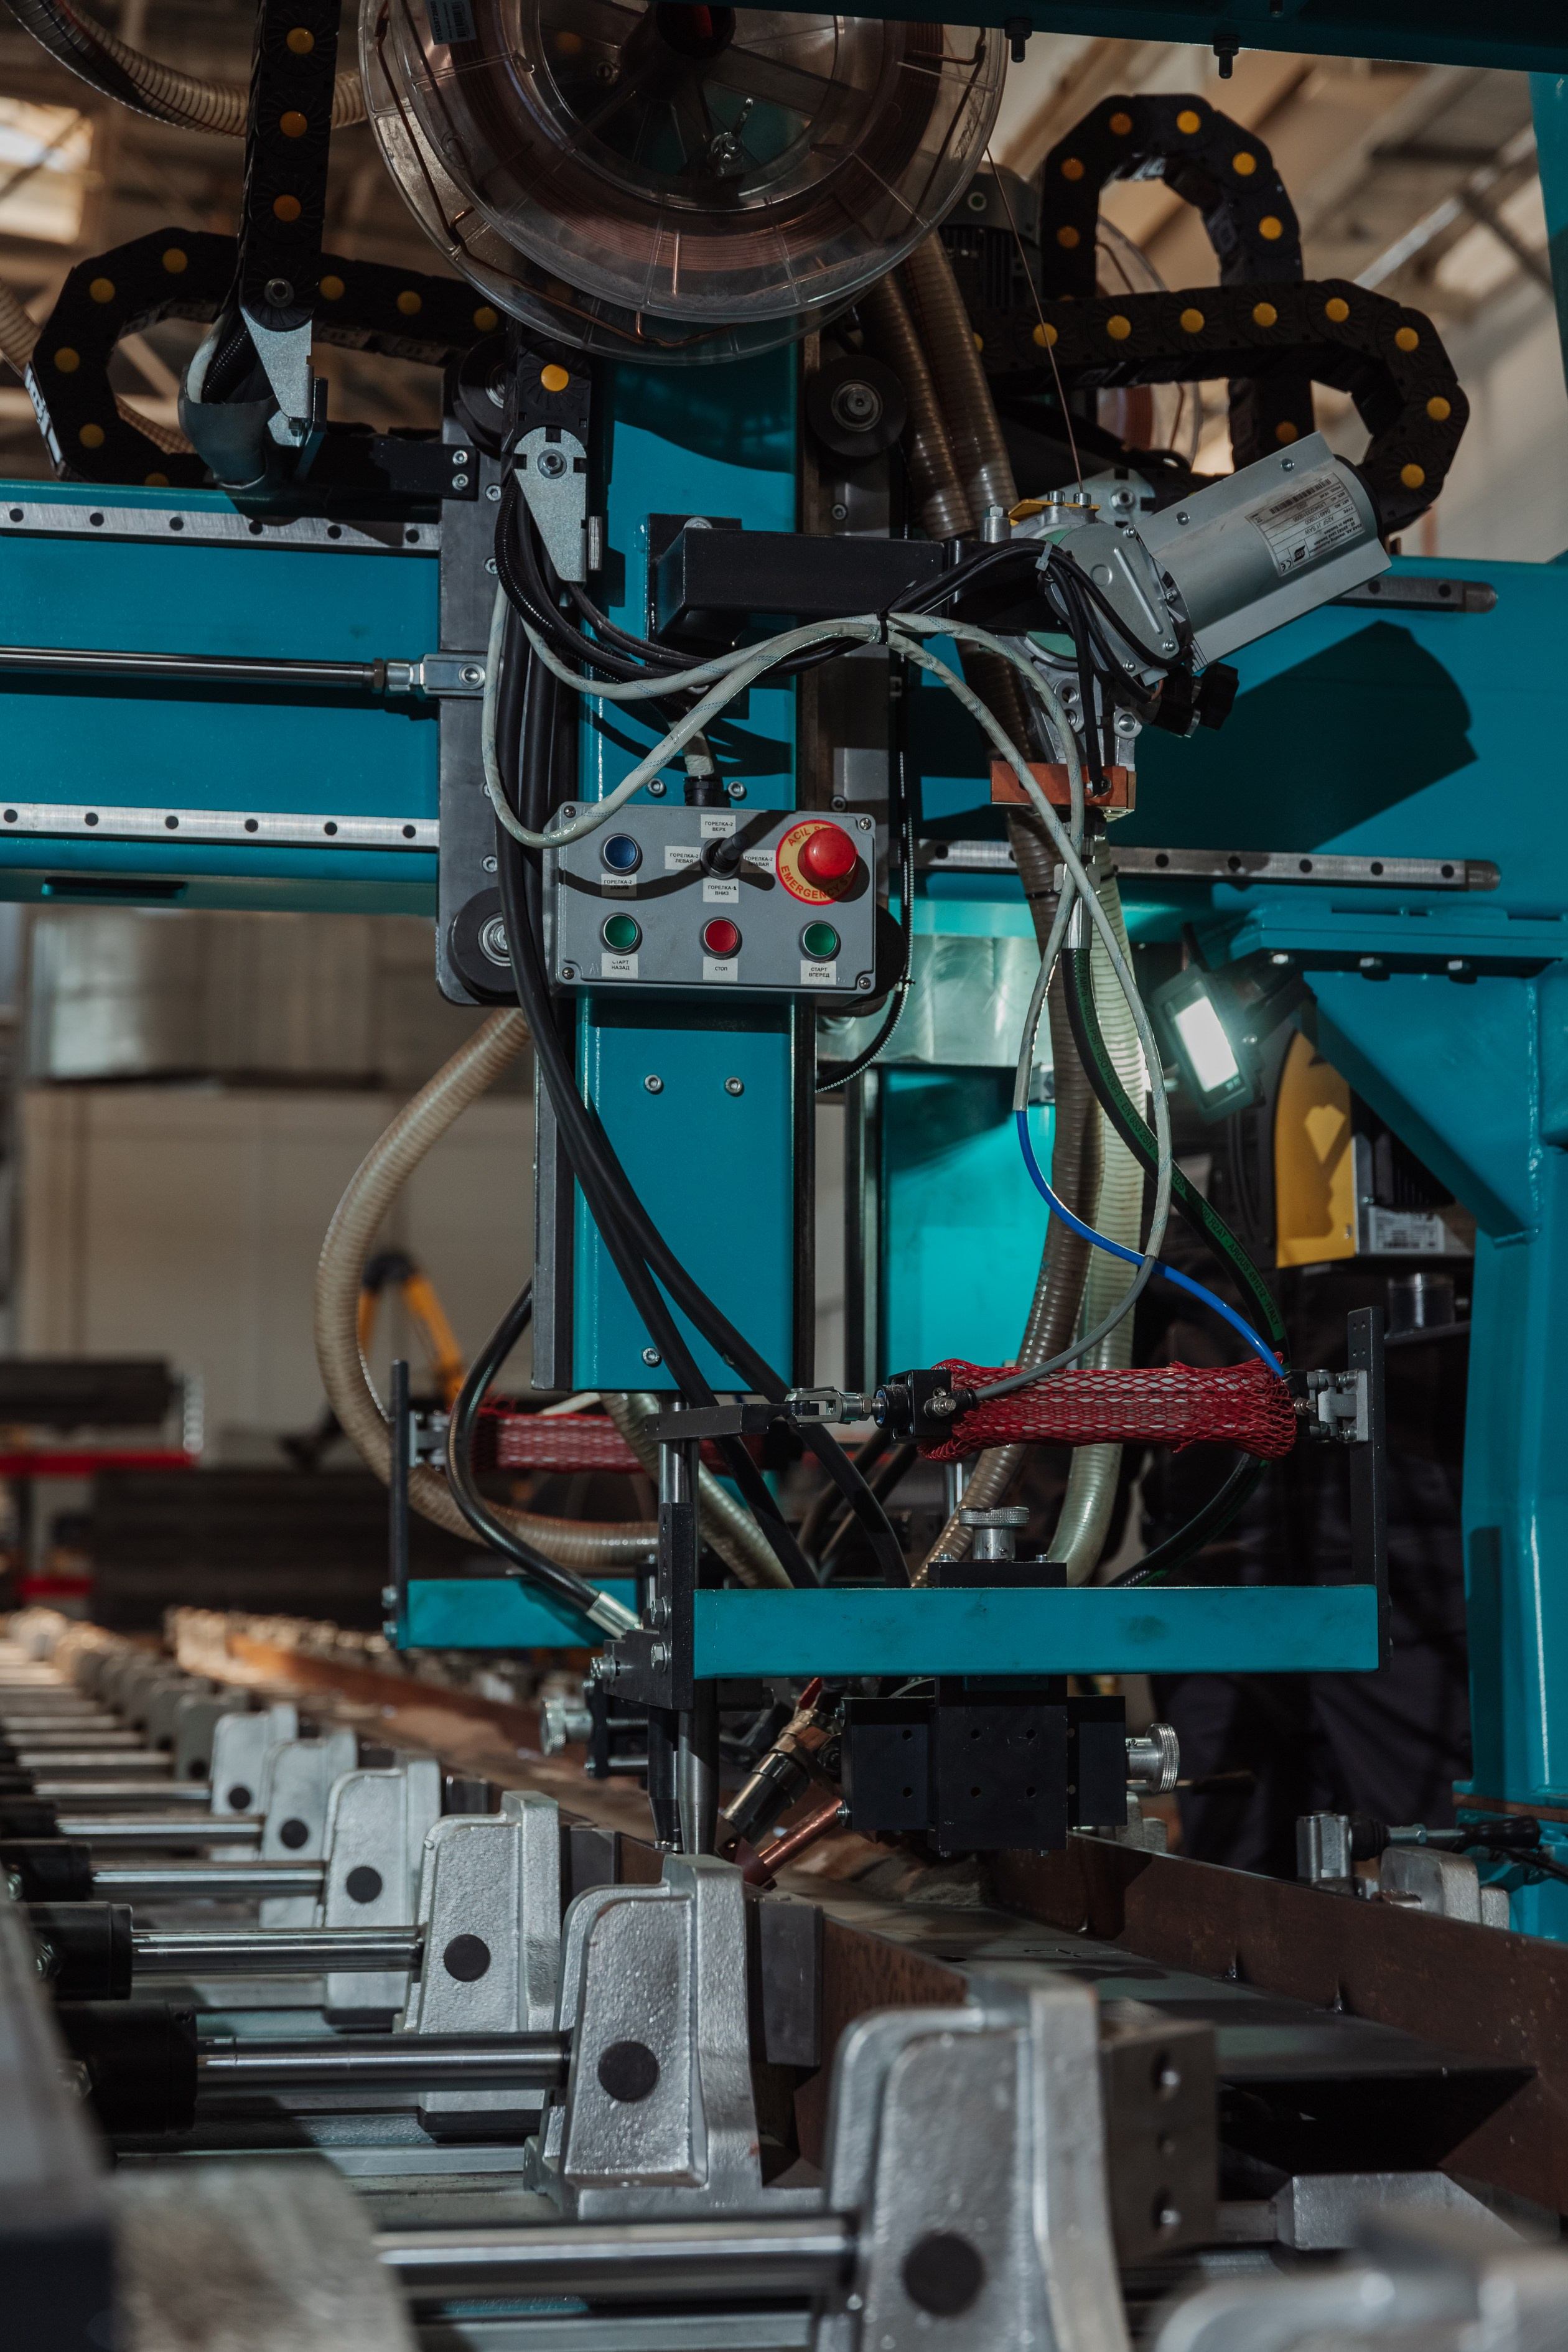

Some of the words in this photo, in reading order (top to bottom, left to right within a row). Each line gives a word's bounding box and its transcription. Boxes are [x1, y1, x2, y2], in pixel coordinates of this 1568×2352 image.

[1322, 516, 1334, 525] A2SF
[1304, 526, 1315, 534] SAW
[781, 866, 841, 899] EMERGENCY
[1078, 956, 1086, 974] 27.5
[1080, 976, 1089, 996] MPa
[1084, 1004, 1095, 1027] 4000
[1090, 1029, 1101, 1045] PSI
[1097, 1052, 1108, 1068] ISO
[1104, 1070, 1121, 1097] 1436-1
[1121, 1103, 1133, 1117] EN
[1129, 1116, 1140, 1132] 853
[1139, 1132, 1155, 1150] 2SN
[1209, 1219, 1226, 1238] R2AT
[1228, 1243, 1251, 1272] ARGUS
[1265, 1301, 1280, 1325] ITALY
